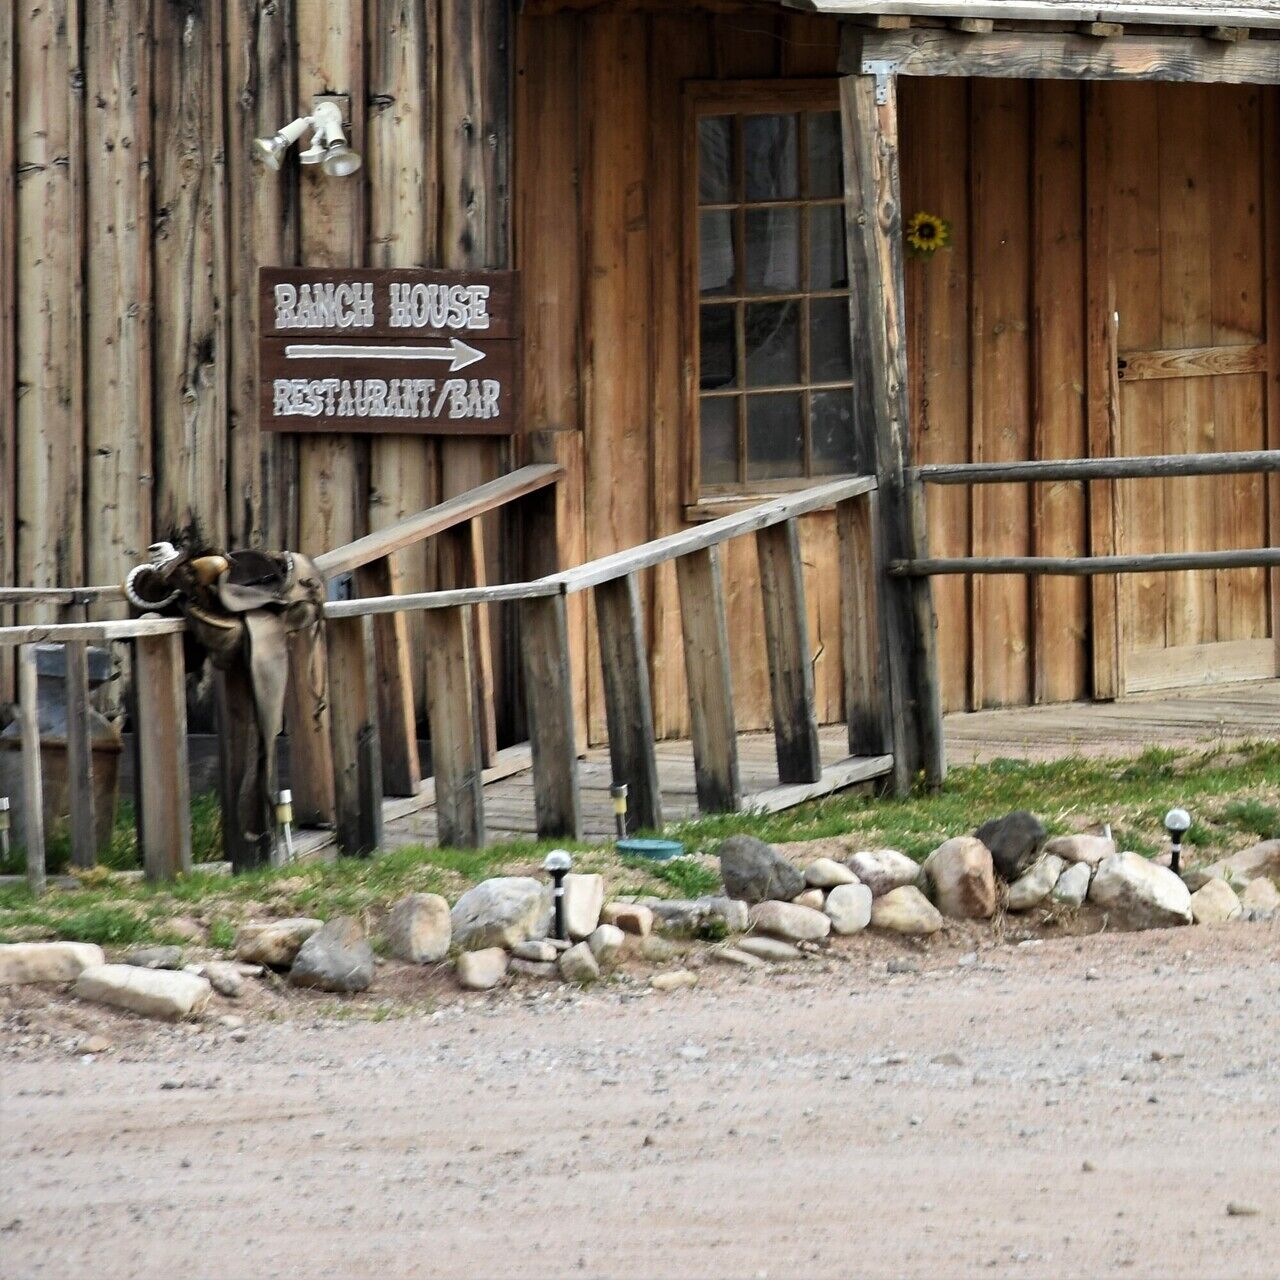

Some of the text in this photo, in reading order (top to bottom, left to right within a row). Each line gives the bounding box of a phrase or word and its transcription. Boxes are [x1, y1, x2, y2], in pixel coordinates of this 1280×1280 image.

[274, 282, 490, 330] RANCH HOUSE
[273, 378, 501, 419] RESTAURANT/BAR
